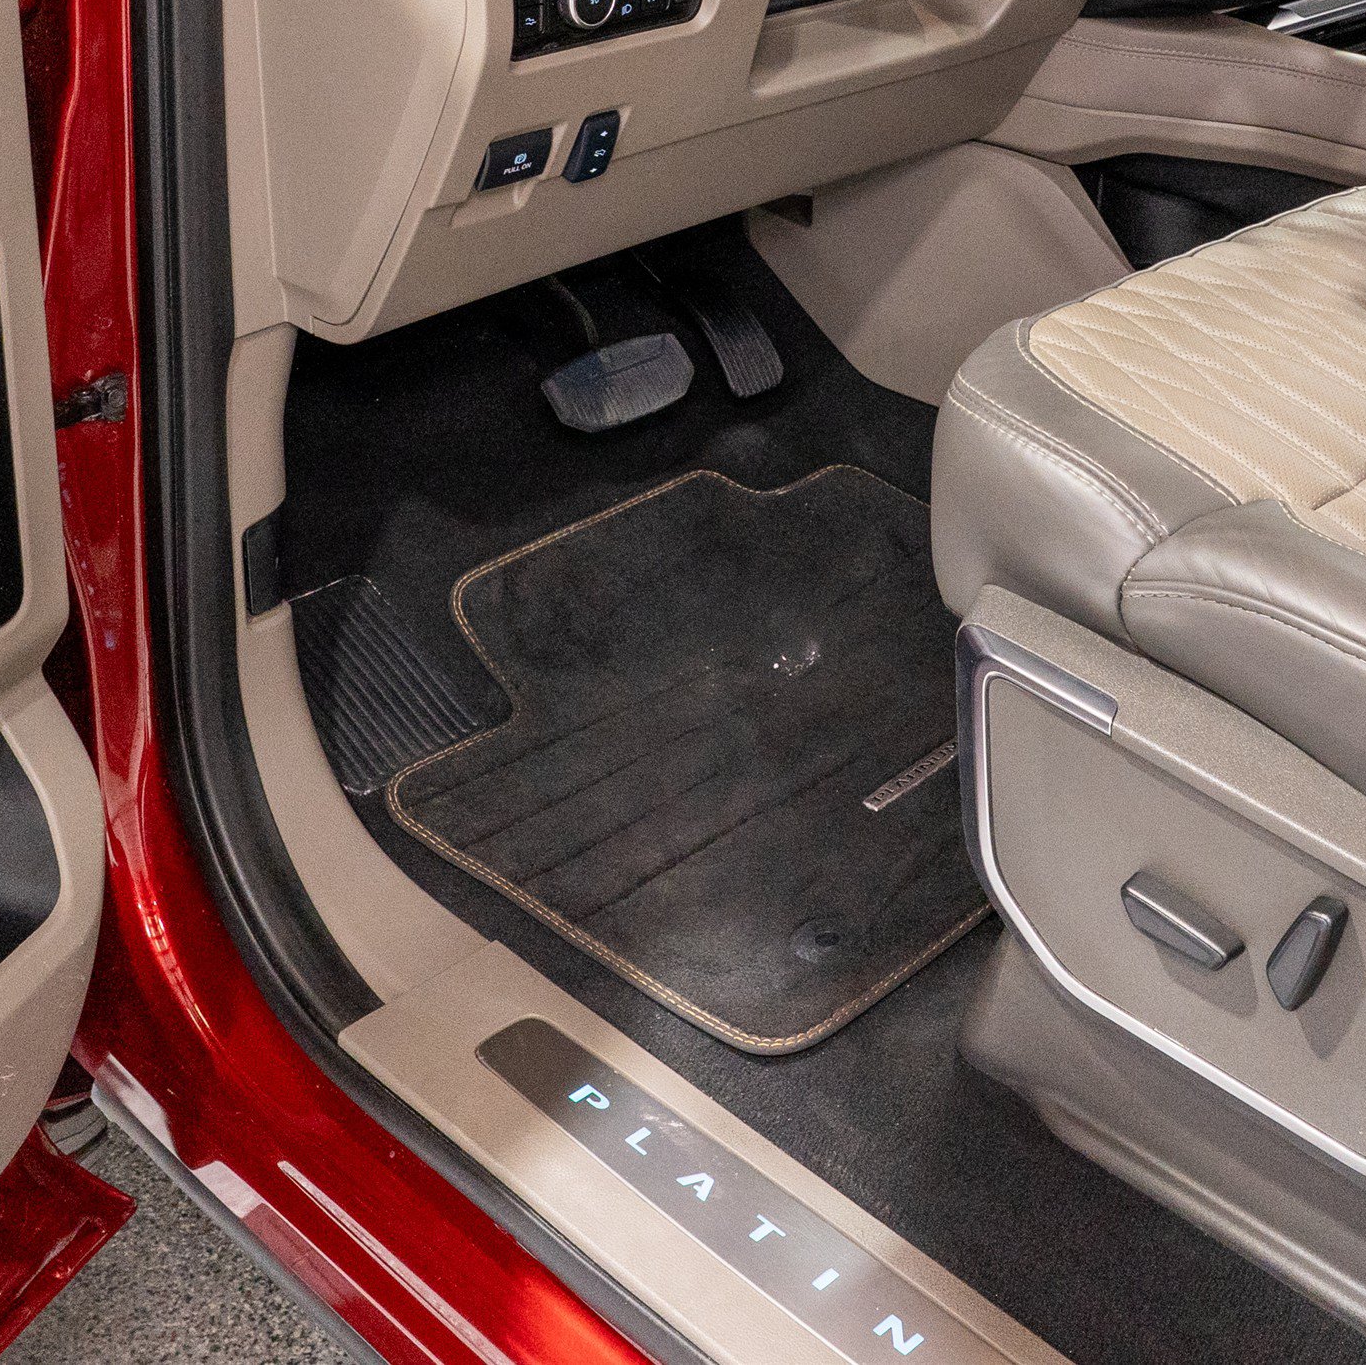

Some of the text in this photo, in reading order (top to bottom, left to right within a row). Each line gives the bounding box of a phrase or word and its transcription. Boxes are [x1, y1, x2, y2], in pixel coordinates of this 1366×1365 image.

[503, 162, 532, 174] PULL ON
[568, 1084, 924, 1356] PLATIN
